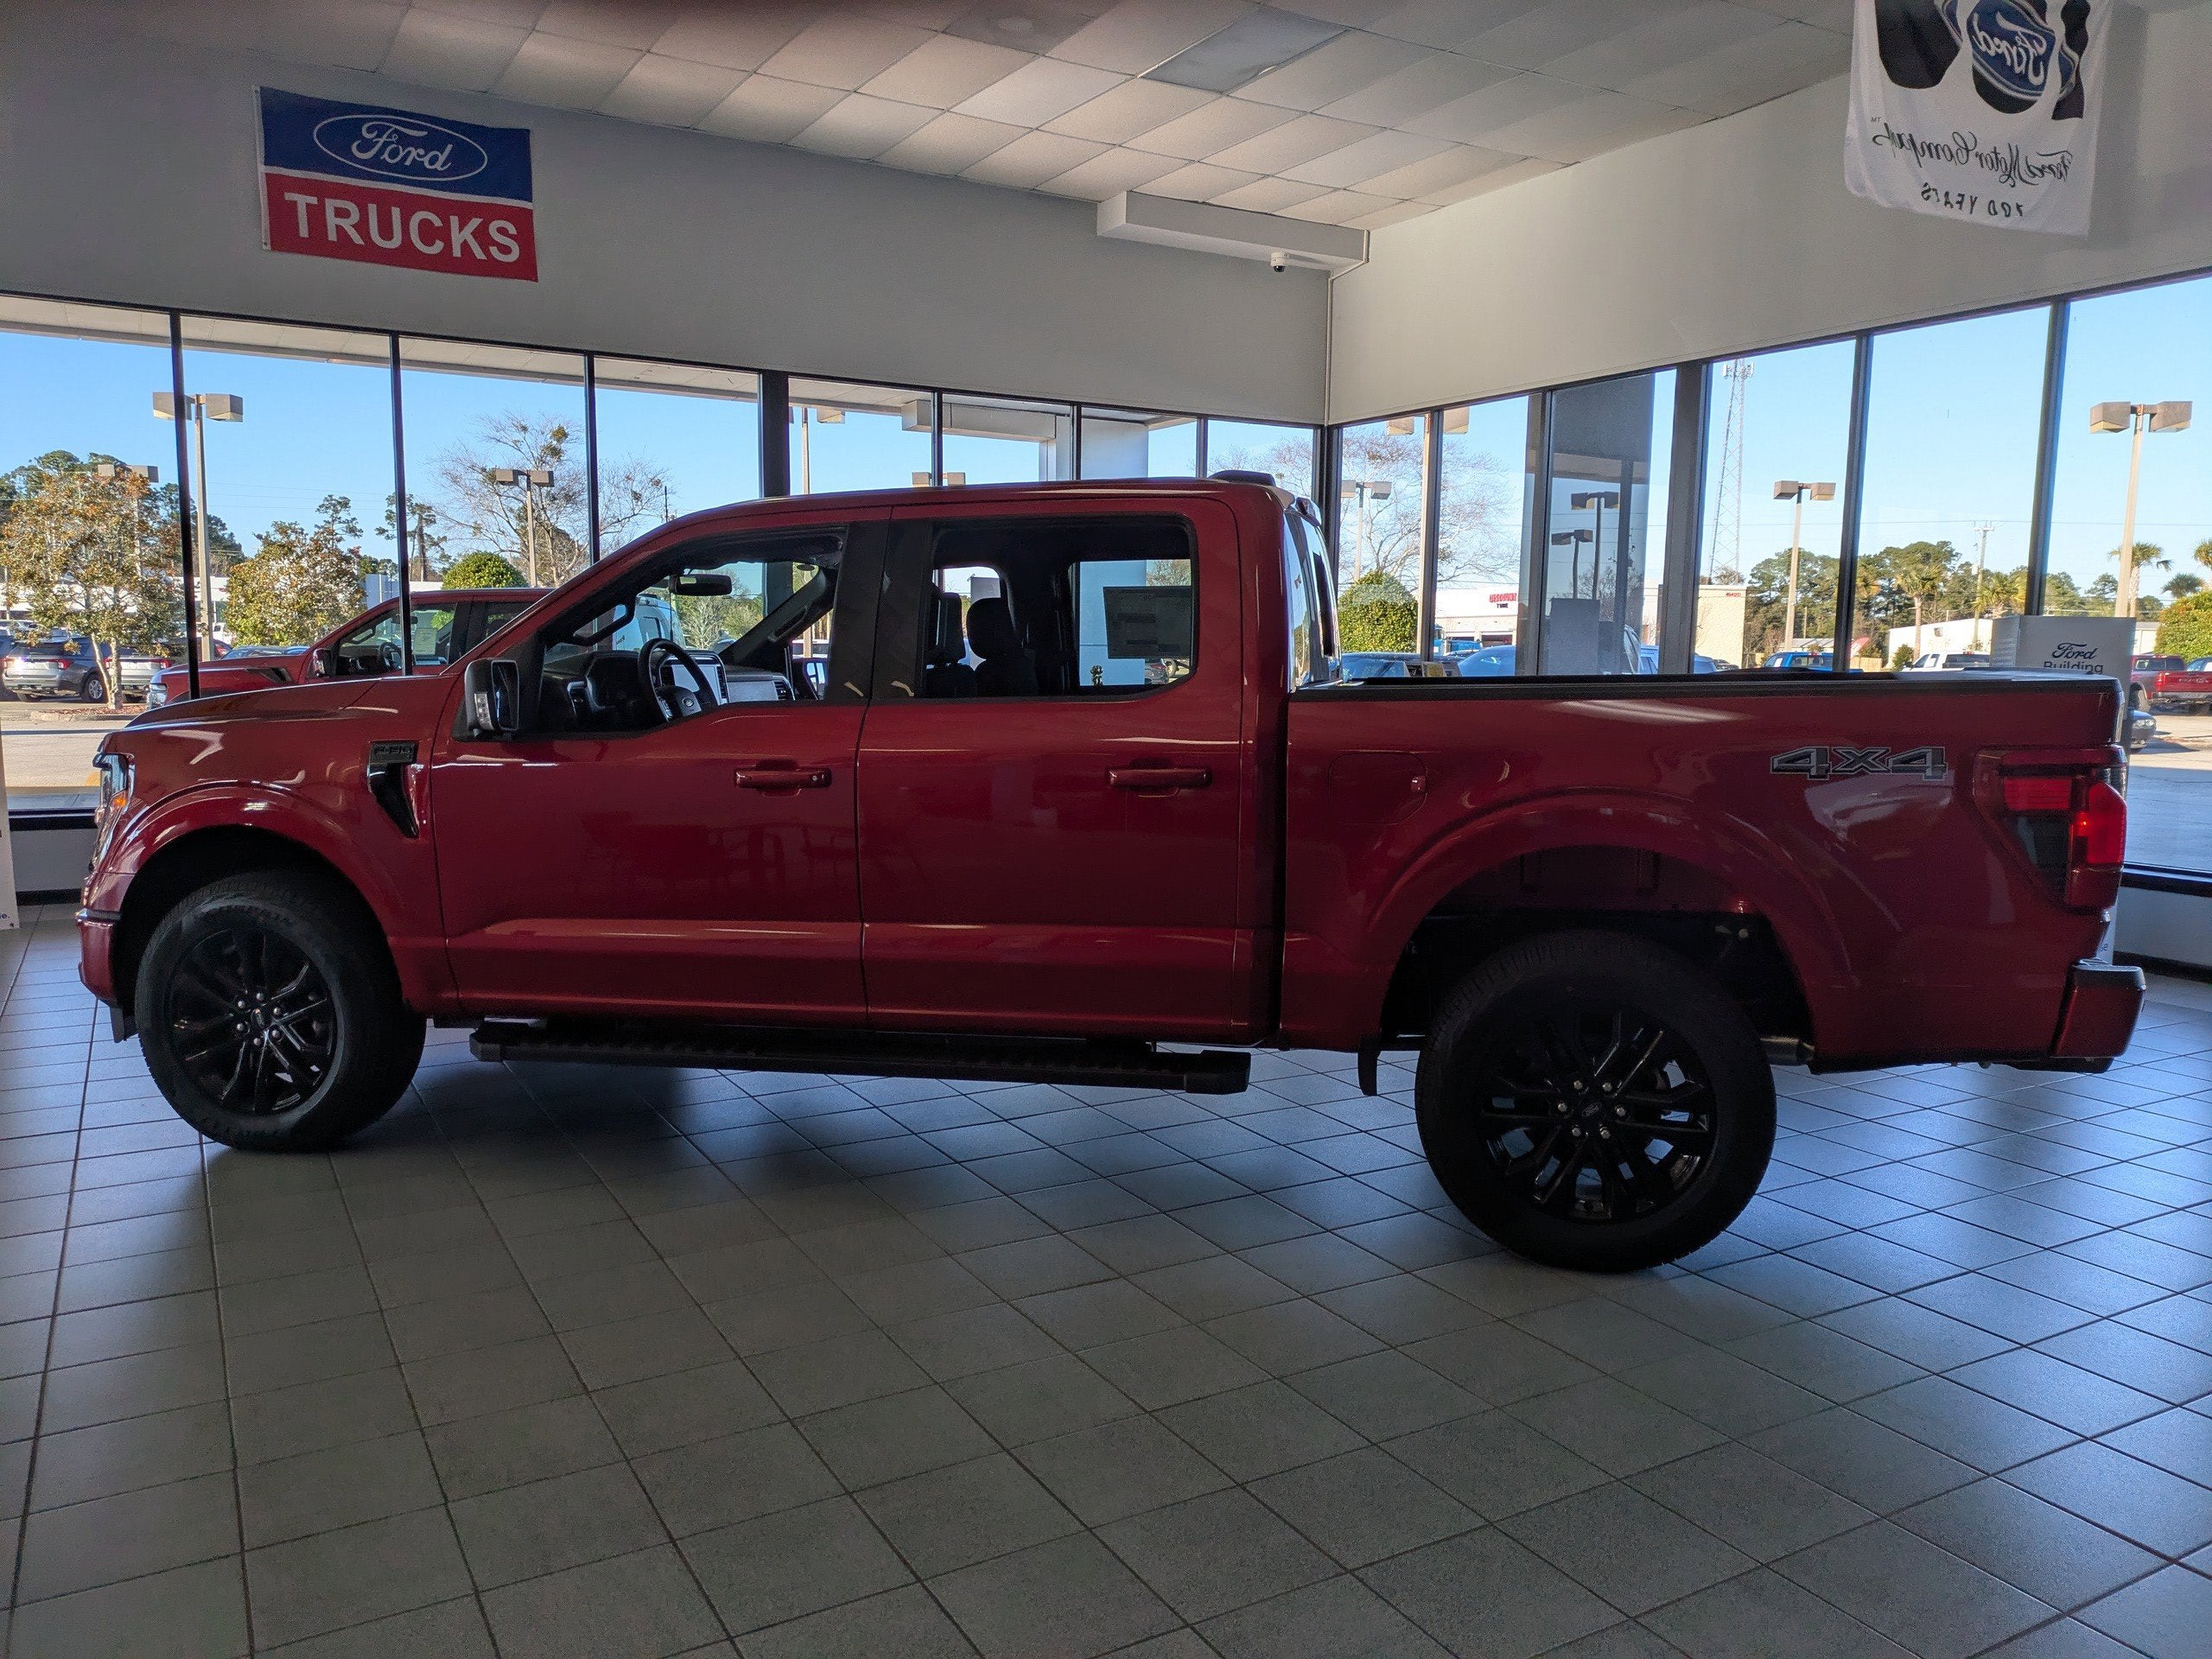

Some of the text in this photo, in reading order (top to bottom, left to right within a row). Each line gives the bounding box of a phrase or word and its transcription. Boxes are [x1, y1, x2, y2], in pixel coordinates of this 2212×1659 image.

[351, 120, 454, 172] Ford
[283, 192, 520, 263] TRUCKS
[2051, 642, 2099, 660] Ford
